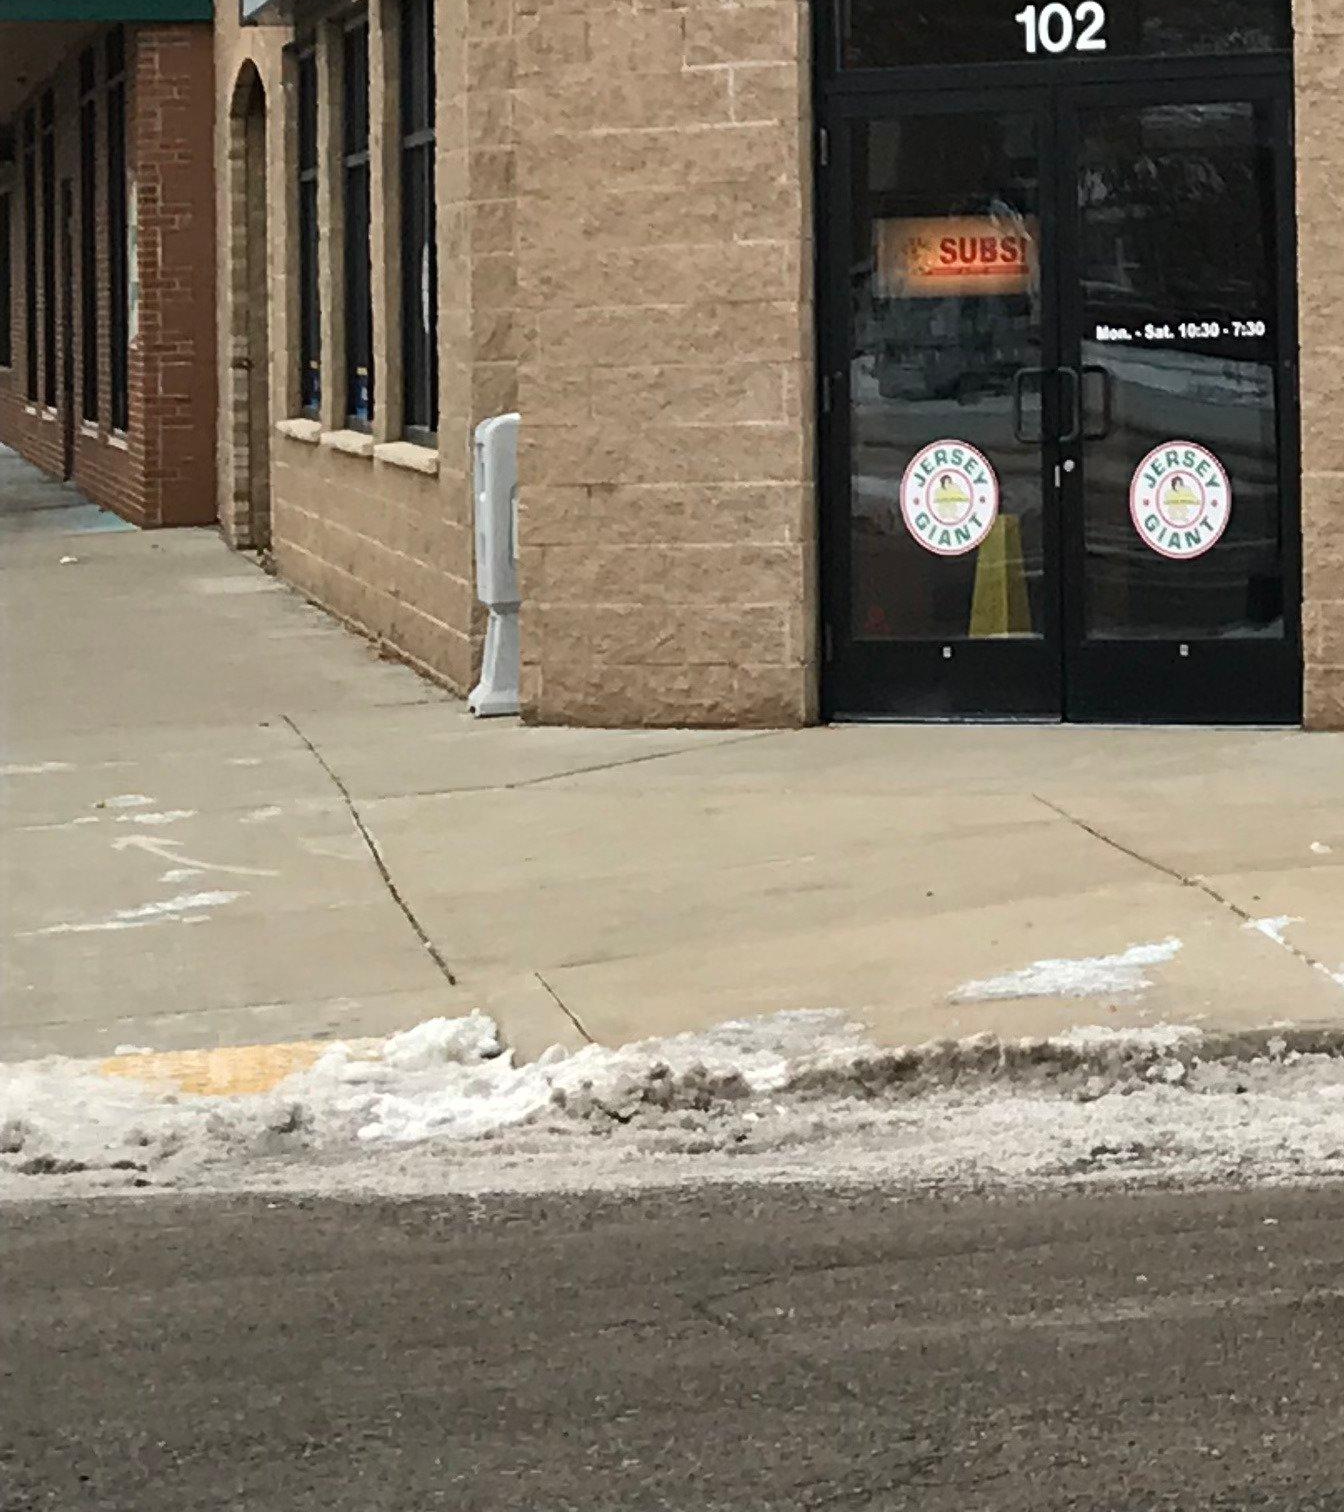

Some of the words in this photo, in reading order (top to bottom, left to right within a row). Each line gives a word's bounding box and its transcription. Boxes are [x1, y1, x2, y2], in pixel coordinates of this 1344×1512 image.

[1015, 1, 1106, 53] 102
[1178, 322, 1220, 338] 10:30
[1231, 320, 1266, 337] 7:30
[914, 449, 987, 487] JERSEY
[1143, 450, 1220, 489] JERSEY
[915, 511, 983, 546] GIANT
[1144, 515, 1214, 550] GIANT
